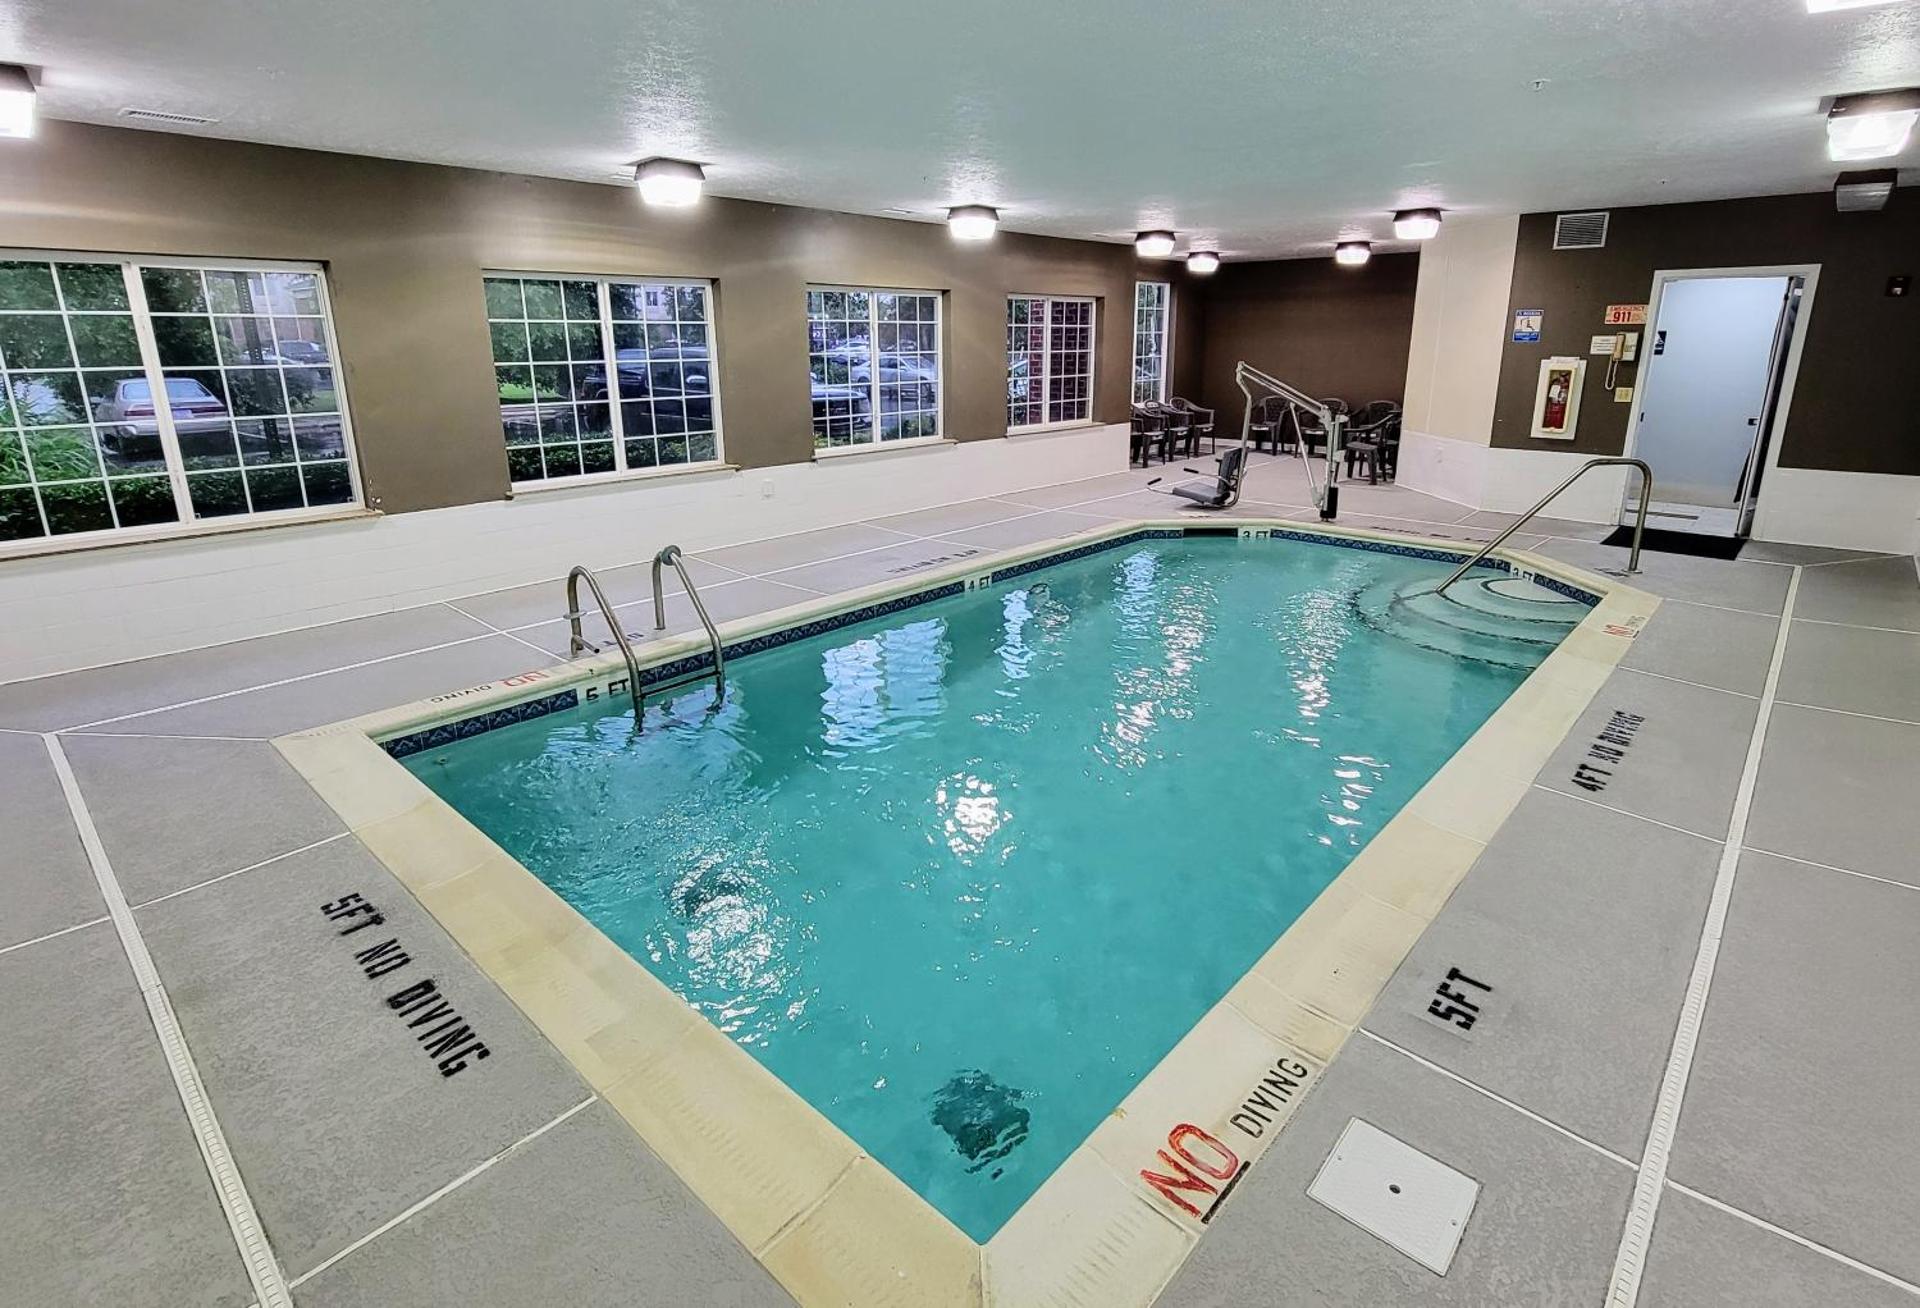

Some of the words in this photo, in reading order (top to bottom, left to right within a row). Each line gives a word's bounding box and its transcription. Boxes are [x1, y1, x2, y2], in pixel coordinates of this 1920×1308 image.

[1612, 311, 1632, 323] 911
[431, 684, 492, 704] DIVING
[586, 687, 600, 701] 5
[608, 678, 629, 696] FT
[1571, 763, 1613, 792] 4FT
[320, 892, 386, 936] 5FT
[355, 938, 412, 980] NO
[386, 978, 491, 1078] DIVING
[1427, 966, 1492, 1031] 5FT
[1140, 1123, 1239, 1218] NO
[1229, 1057, 1309, 1139] DIVING
